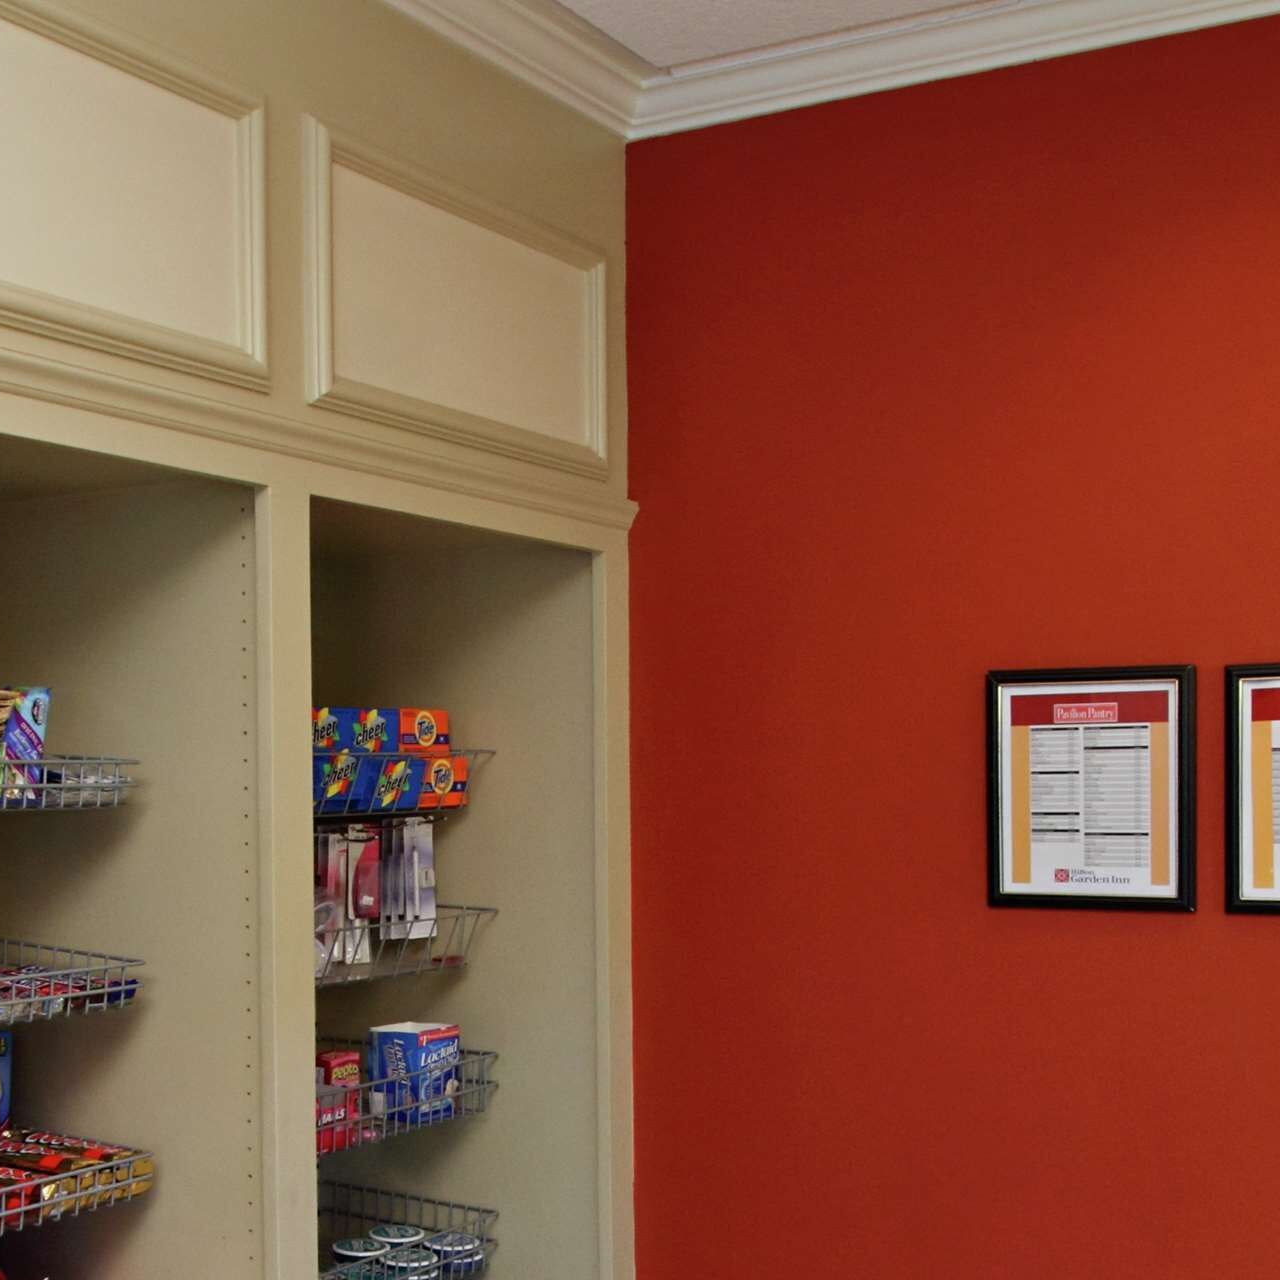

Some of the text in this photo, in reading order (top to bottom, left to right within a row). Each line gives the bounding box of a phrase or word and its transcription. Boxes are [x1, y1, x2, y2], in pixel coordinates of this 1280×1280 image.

[1056, 707, 1115, 720] Pavilion Pantry
[355, 722, 387, 746] cheer
[416, 720, 435, 739] Tide
[433, 767, 452, 788] Tide
[1070, 875, 1131, 885] Garden Inn
